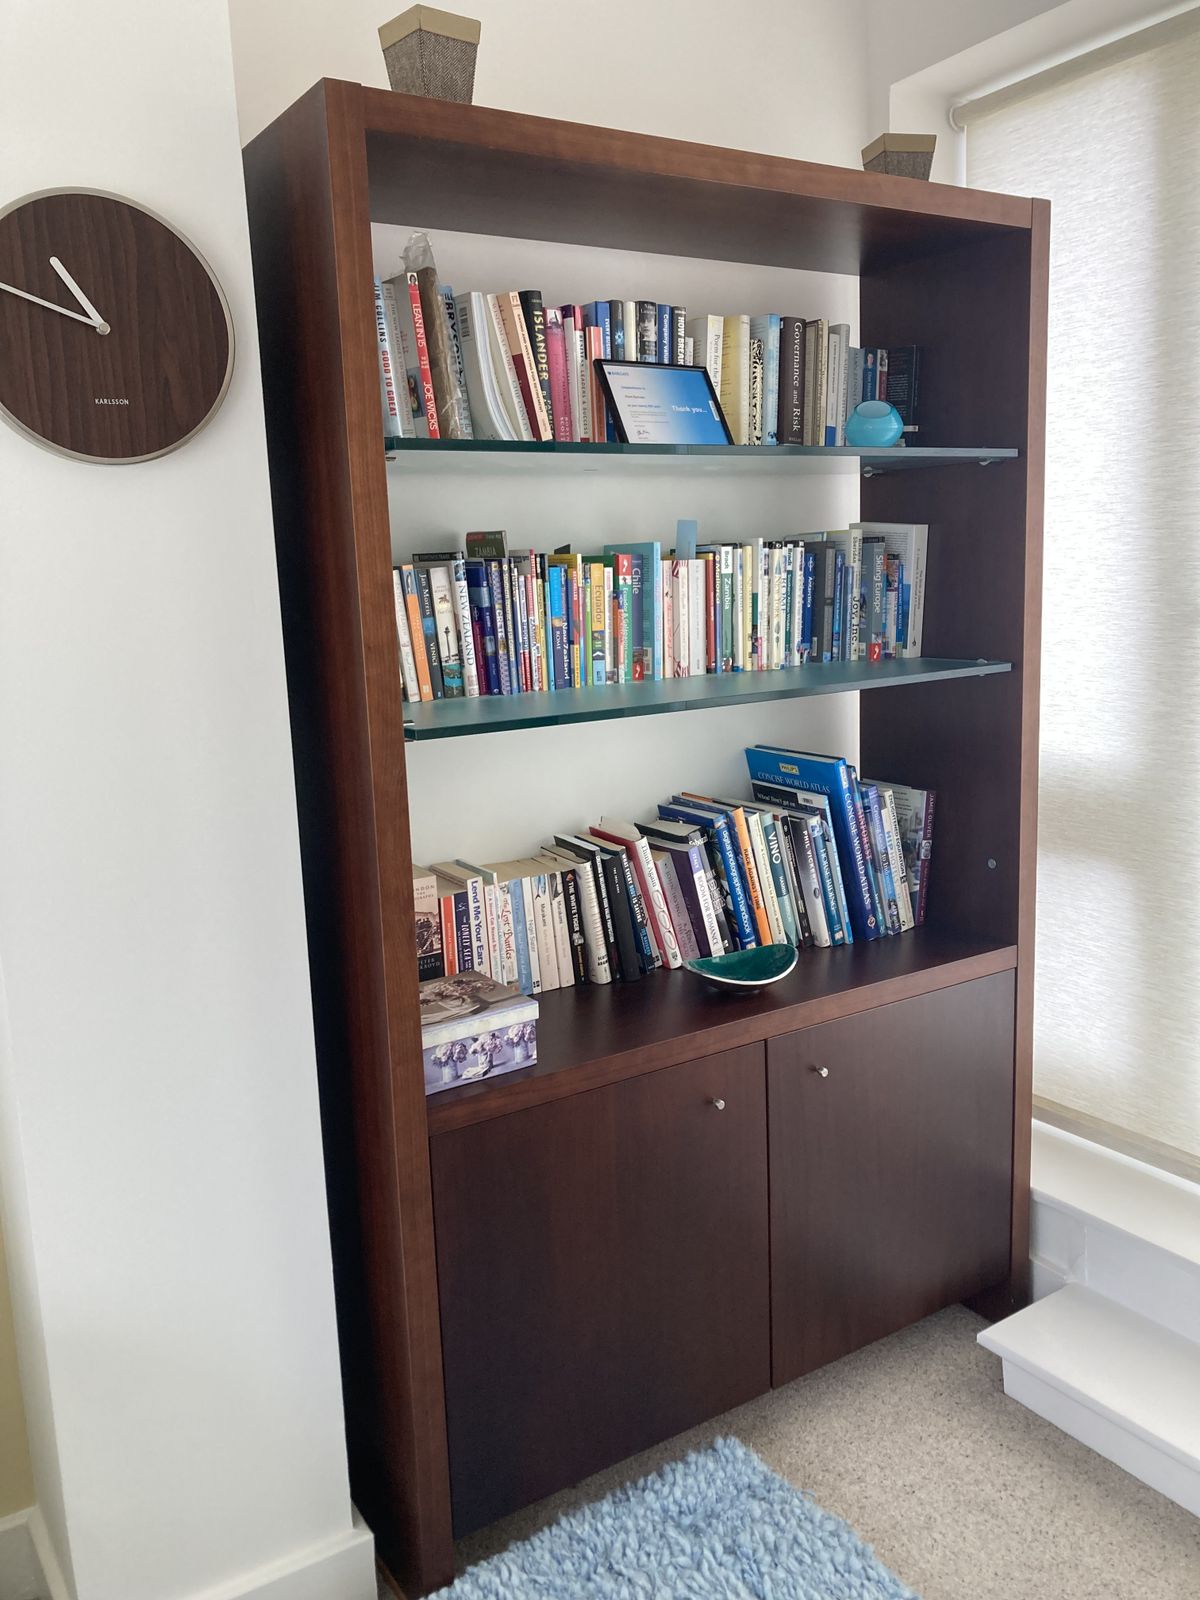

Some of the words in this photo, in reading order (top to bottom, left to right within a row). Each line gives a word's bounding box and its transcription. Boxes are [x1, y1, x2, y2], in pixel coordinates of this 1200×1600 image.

[376, 305, 386, 342] COLLINS
[412, 304, 424, 326] LEAN
[416, 328, 425, 338] IN
[418, 339, 426, 348] 15
[533, 311, 549, 380] ISLANDER
[382, 351, 391, 374] GOOD
[793, 322, 802, 387] Governance
[385, 376, 392, 387] TO
[424, 382, 433, 400] JOE
[387, 390, 397, 416] GREAT
[427, 400, 438, 430] WICKS
[792, 408, 801, 432] Risk
[475, 546, 496, 557] ZAMBIA
[419, 574, 428, 586] Jan
[874, 555, 882, 580] Skiing
[632, 568, 640, 594] Chile
[422, 588, 432, 616] Morris
[459, 585, 470, 611] NEW
[595, 585, 604, 624] Ecuador
[874, 582, 882, 614] Europe
[496, 610, 504, 638] CRETE
[851, 624, 860, 645] Inc.
[462, 614, 474, 666] ZEALAND
[430, 642, 438, 666] VENICE
[758, 772, 784, 783] CONCISE
[785, 776, 810, 788] WORLD
[810, 782, 831, 793] ATLAS
[722, 830, 732, 850] digital
[888, 794, 898, 837] ENLIGHTENED
[896, 838, 906, 876] EQUITATION
[622, 853, 630, 868] WHAT
[768, 832, 782, 864] VINO
[845, 793, 858, 836] CONCISE
[852, 838, 864, 874] WORLD
[860, 876, 870, 905] ATLAS
[624, 870, 633, 885] EVERY
[640, 845, 652, 866] Think
[648, 868, 657, 888] Again
[726, 852, 742, 902] photographer's
[820, 848, 829, 878] HORSE
[827, 879, 838, 910] RIDING
[471, 880, 480, 904] Lend
[747, 867, 757, 893] AGAINST
[666, 871, 676, 890] JOHN
[671, 892, 682, 918] IRVING
[473, 906, 482, 920] Me
[501, 908, 512, 926] Lost
[634, 903, 642, 922] SAYING
[698, 876, 706, 897] ROOM
[706, 912, 718, 946] ROMANCE
[738, 901, 750, 934] handbook
[462, 924, 470, 946] LONELY
[606, 920, 614, 943] PROPOSITION
[464, 948, 472, 960] SEA
[504, 929, 515, 960] Battles
